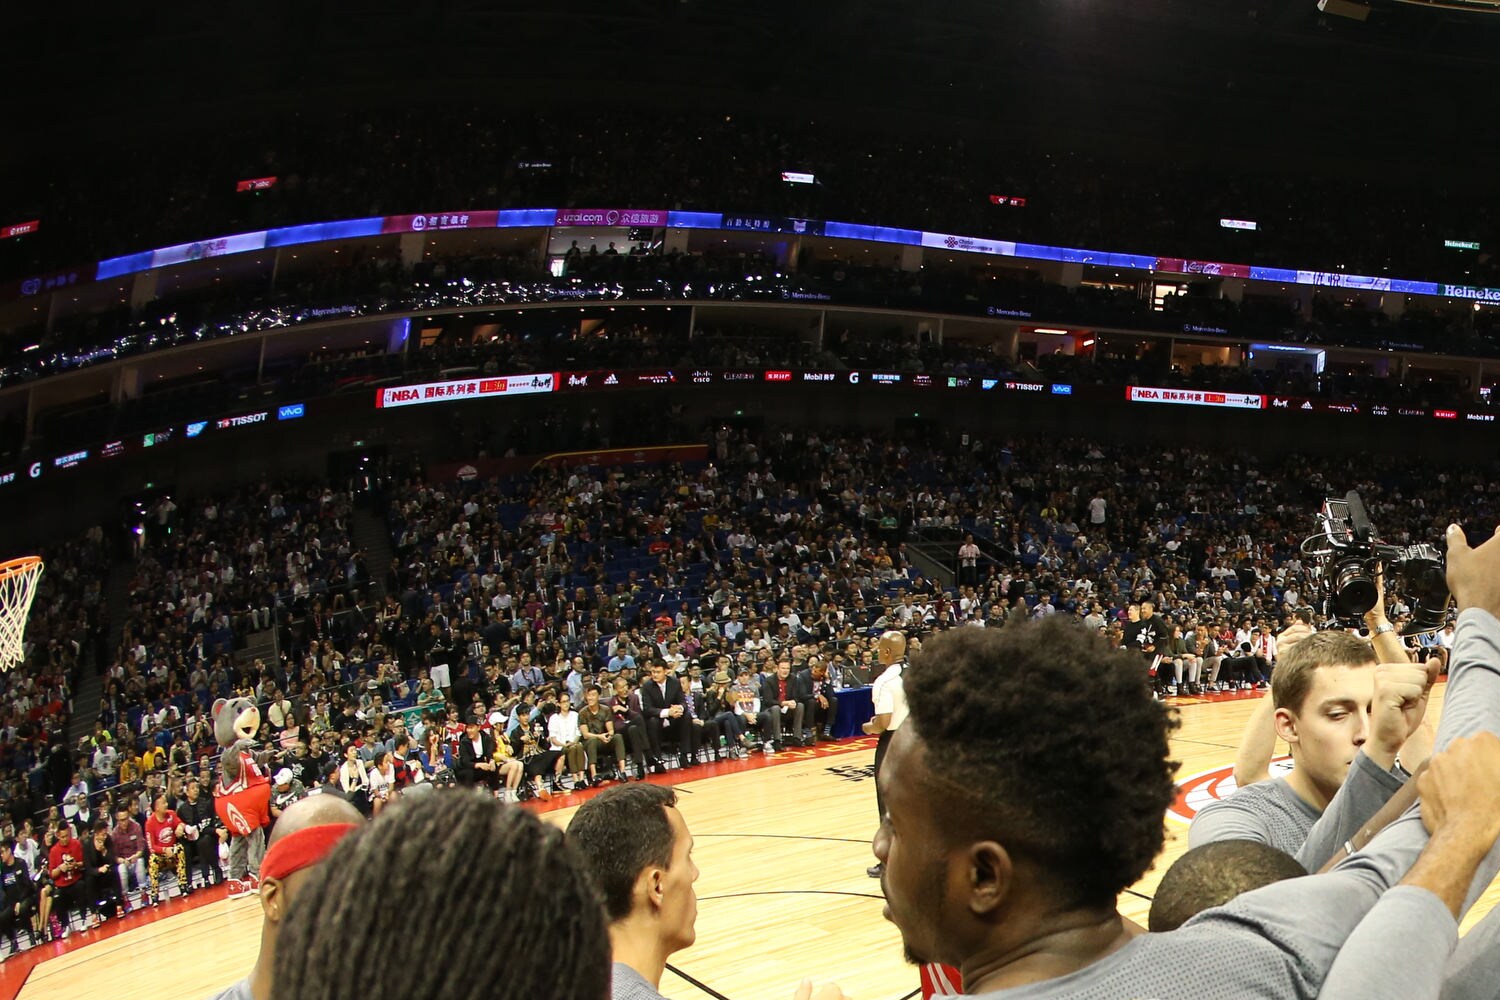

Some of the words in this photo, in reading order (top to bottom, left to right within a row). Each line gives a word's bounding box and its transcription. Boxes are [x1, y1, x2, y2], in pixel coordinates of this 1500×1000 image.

[996, 308, 1032, 317] Mercedes-Benz
[804, 373, 823, 381] Mobil
[849, 372, 859, 384] G
[1015, 382, 1044, 391] TISSOT
[392, 389, 420, 402] NBA
[424, 383, 477, 398] 国际系列赛
[1137, 390, 1159, 399] NBA
[280, 406, 302, 417] vivo
[1467, 412, 1482, 420] Mobil
[231, 412, 268, 427] TISSOT
[29, 462, 41, 478] G
